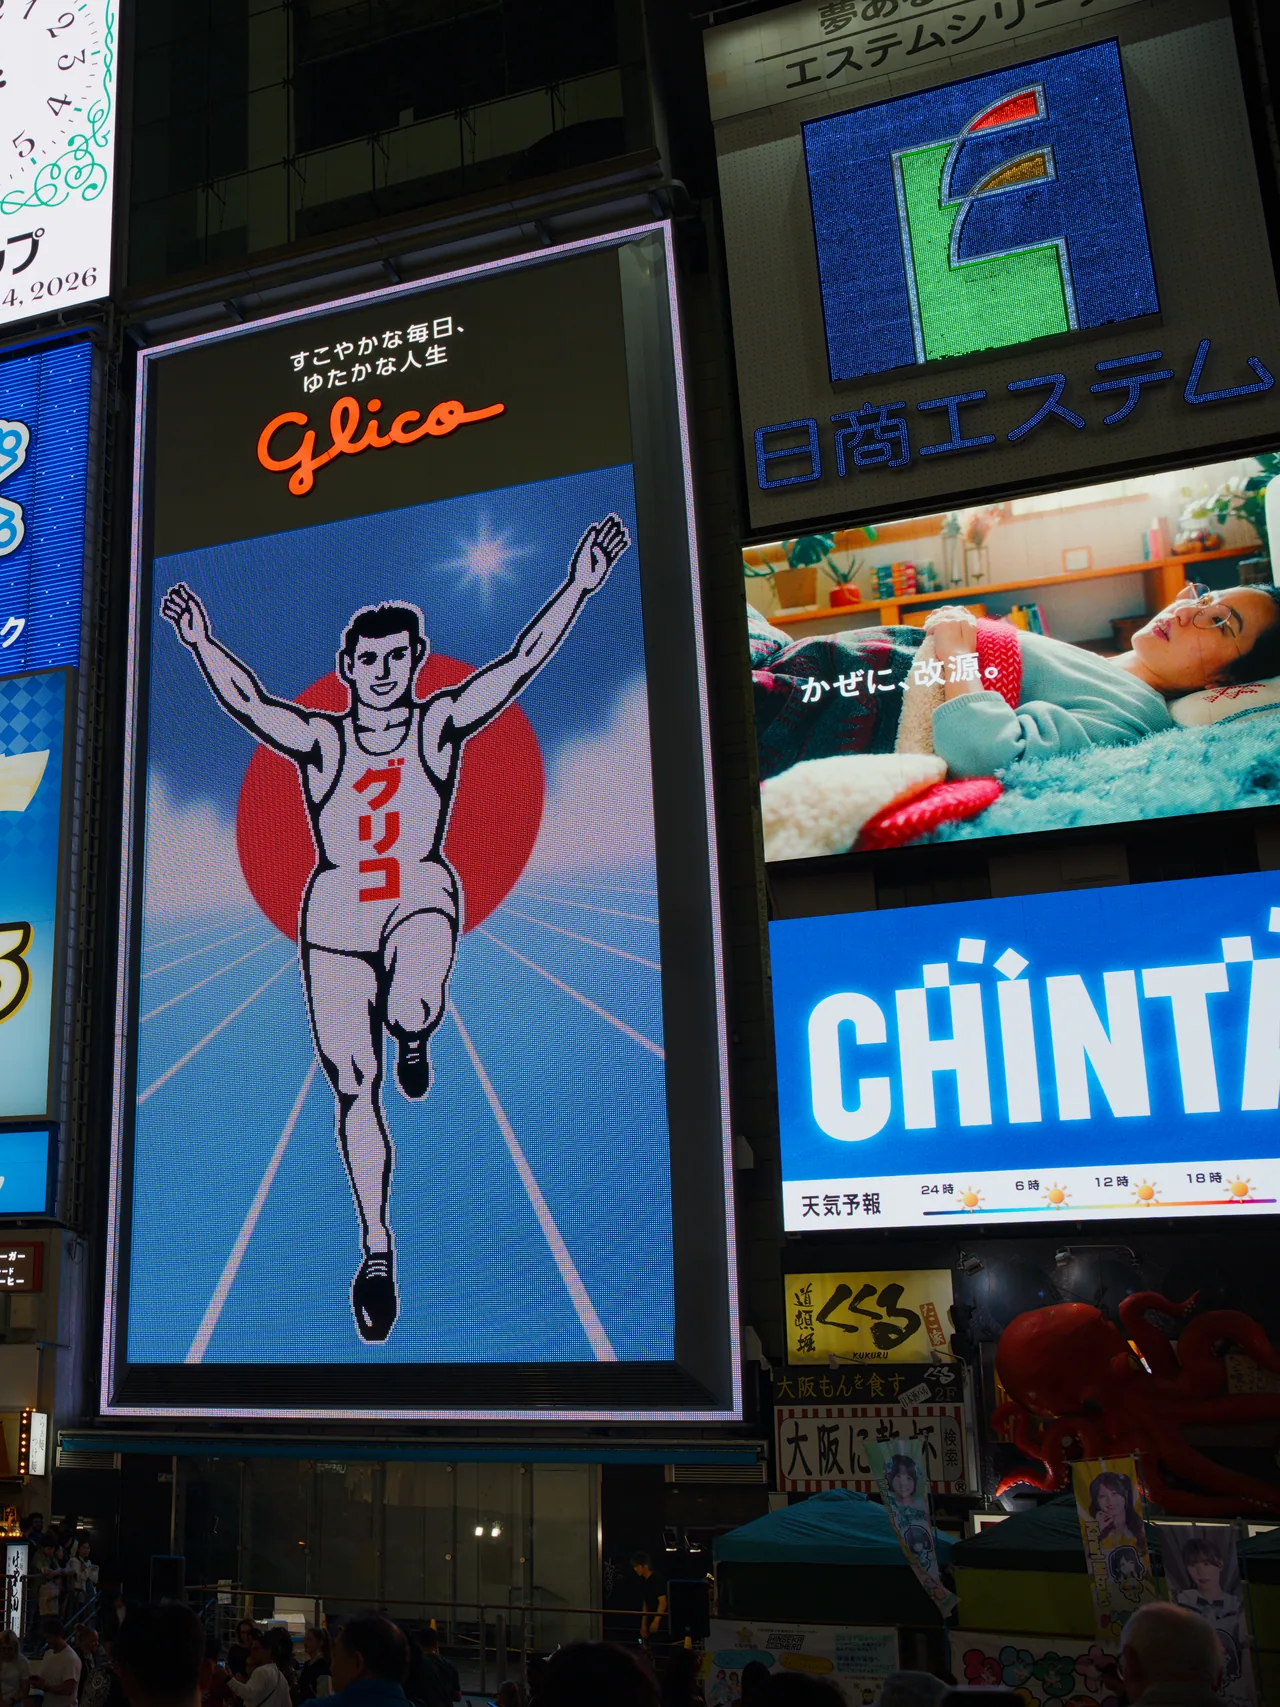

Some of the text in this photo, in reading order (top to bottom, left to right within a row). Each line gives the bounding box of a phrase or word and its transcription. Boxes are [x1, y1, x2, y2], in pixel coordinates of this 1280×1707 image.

[47, 12, 75, 38] 2
[57, 49, 86, 71] 3
[786, 0, 1094, 88] エステムシリー
[46, 94, 72, 117] 4
[12, 130, 35, 158] 5
[31, 266, 98, 302] 2026
[290, 316, 465, 371] すこやかな毎日、
[303, 344, 448, 393] ゆたかな人生
[754, 339, 1276, 490] 日商エステム
[257, 396, 505, 496] Glico
[801, 652, 999, 705] かぜに、改源。
[352, 757, 405, 903] グリコ
[801, 1192, 882, 1219] 天気予報
[817, 1283, 922, 1350] くくる
[852, 1351, 889, 1360] KUKURU
[776, 1371, 905, 1400] 大阪もんを食す
[935, 1386, 959, 1402] 2F
[943, 1428, 959, 1467] 検索
